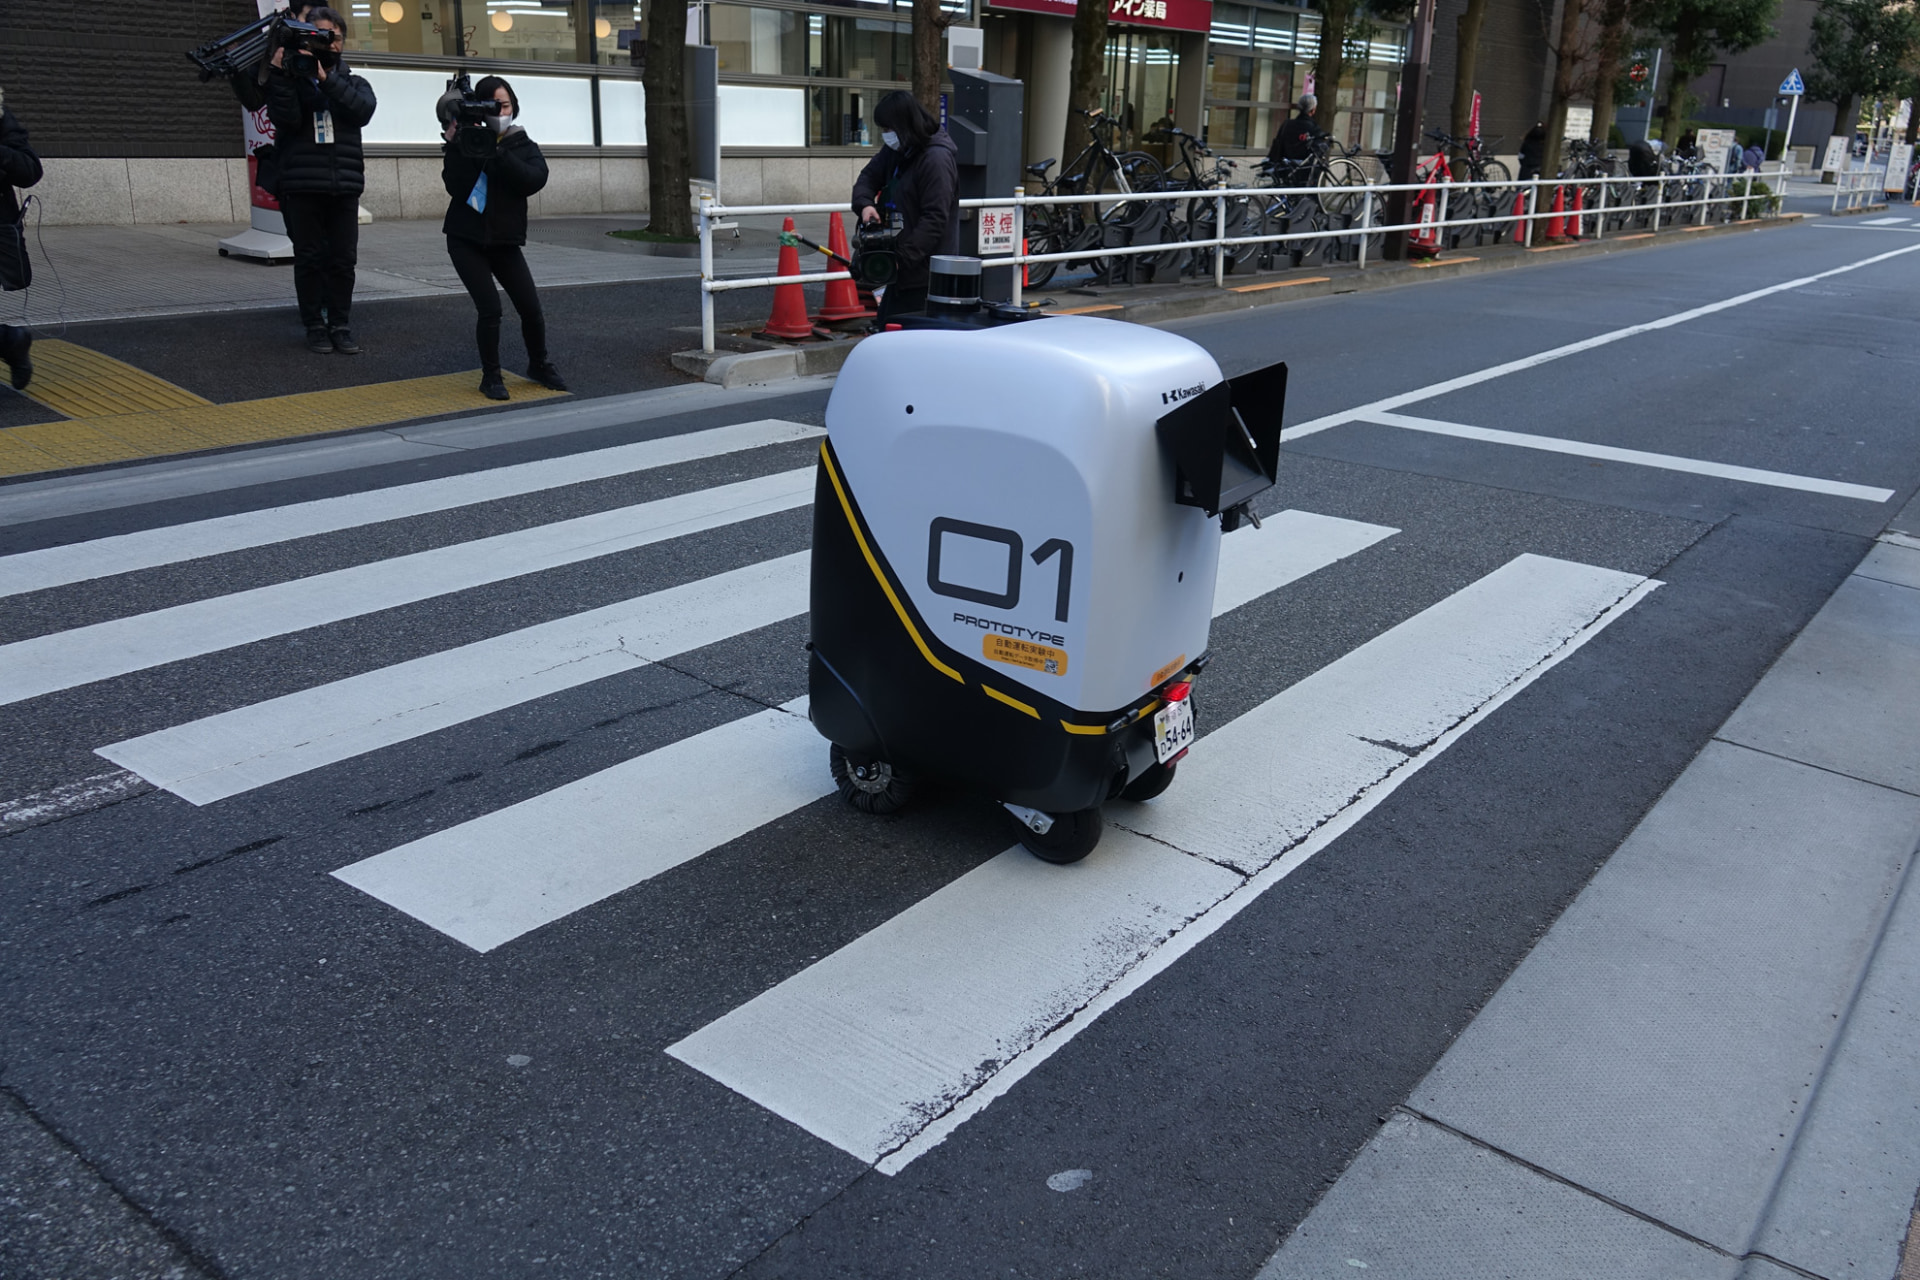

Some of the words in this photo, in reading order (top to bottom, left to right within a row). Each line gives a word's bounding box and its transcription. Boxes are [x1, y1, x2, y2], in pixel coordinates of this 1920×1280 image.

[983, 212, 1013, 236] 禁煙
[1177, 381, 1206, 401] Kawasaki
[926, 516, 1074, 623] 01
[953, 612, 1065, 647] PROTOTYPE
[996, 638, 1055, 658] 自動運転実験中
[1165, 716, 1192, 752] 54-64
